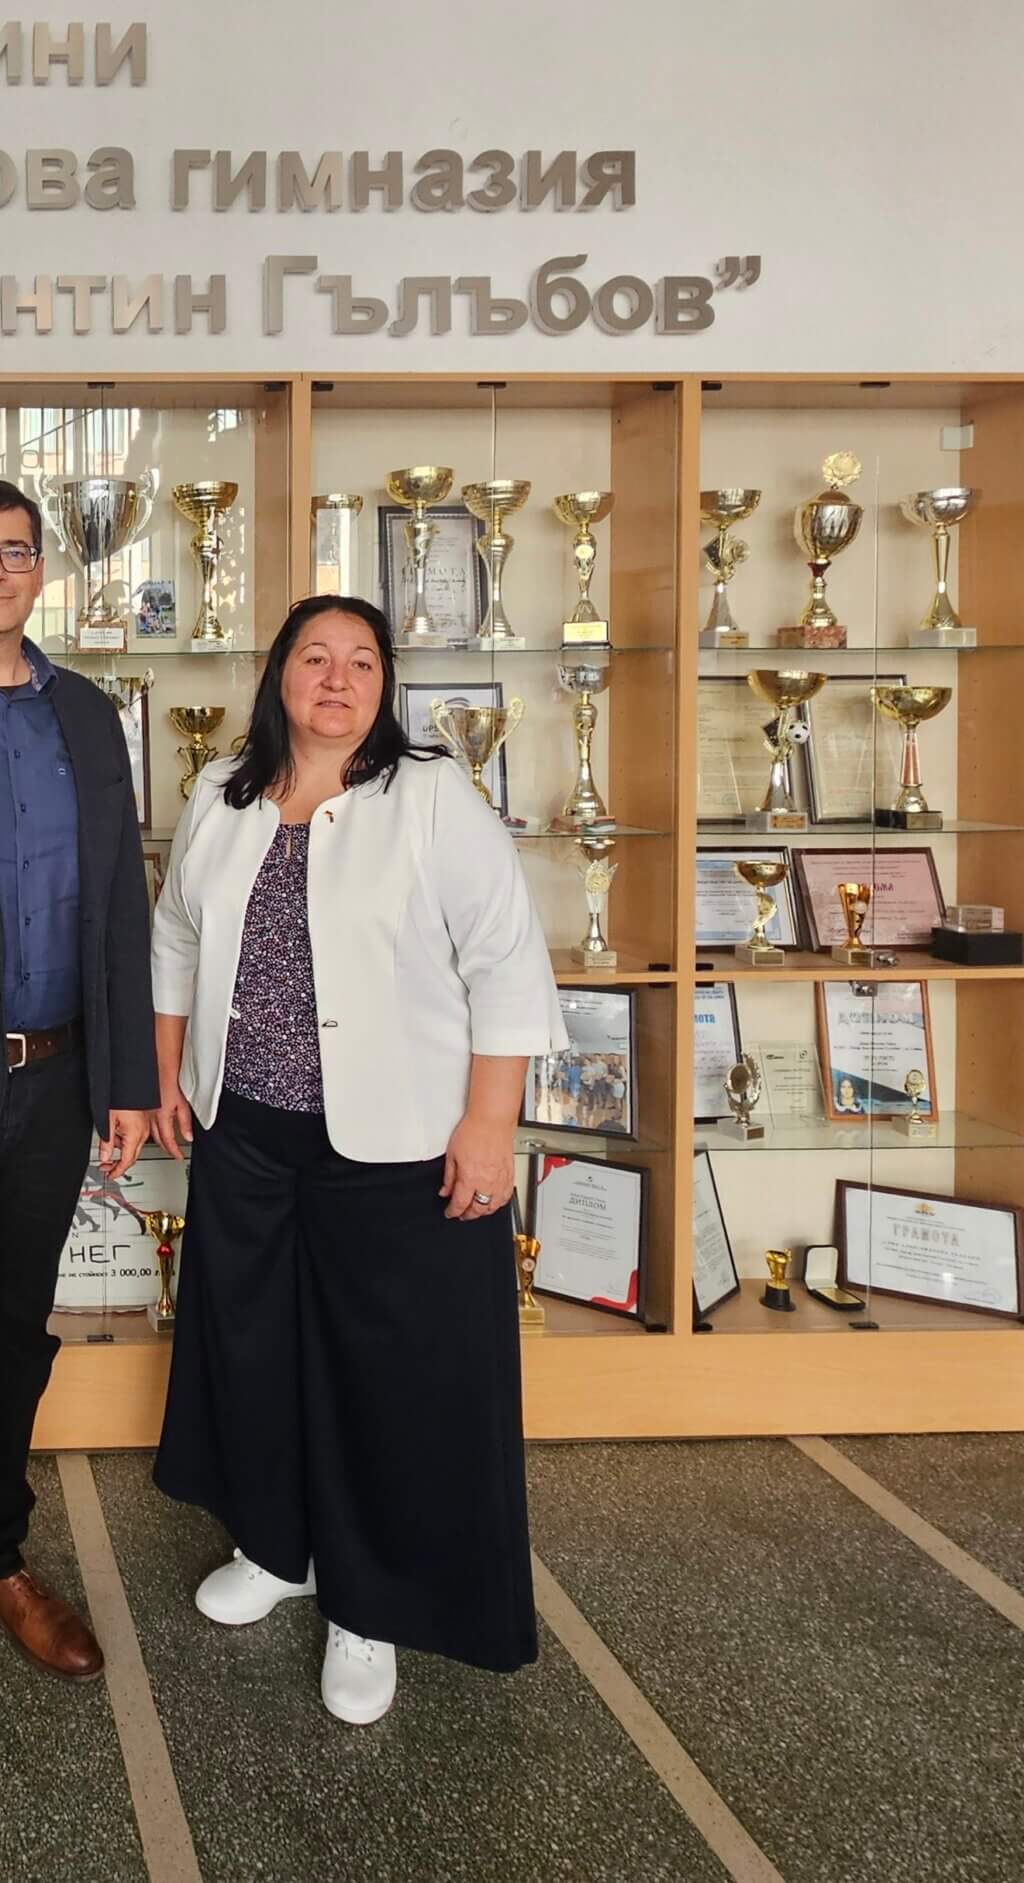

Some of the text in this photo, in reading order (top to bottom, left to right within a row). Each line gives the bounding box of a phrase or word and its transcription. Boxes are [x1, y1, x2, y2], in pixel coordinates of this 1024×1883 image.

[170, 148, 636, 213] гимназия
[568, 1196, 607, 1210] ДИПЛОМ
[893, 1222, 961, 1247] ГРАМОТА
[69, 1244, 132, 1264] НЕГ
